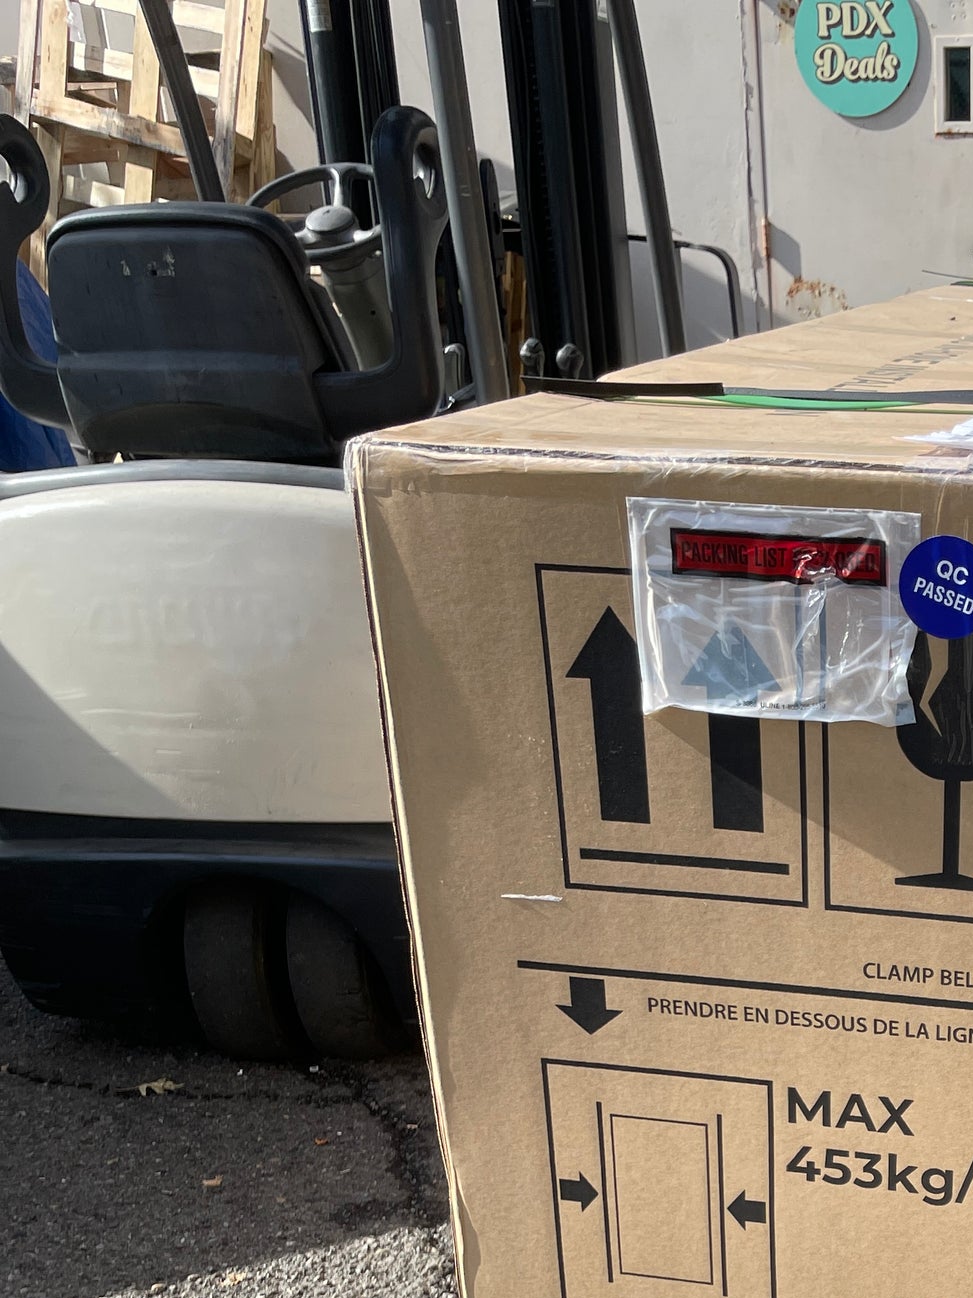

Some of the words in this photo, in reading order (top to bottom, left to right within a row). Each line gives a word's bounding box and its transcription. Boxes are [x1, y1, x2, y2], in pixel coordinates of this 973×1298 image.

[816, 1, 895, 39] PDX
[813, 41, 901, 84] Deals
[681, 541, 748, 565] PACKING
[754, 546, 787, 568] LIST
[936, 560, 969, 585] QC
[862, 962, 934, 985] CLAMP
[646, 997, 738, 1021] PRENDRE
[743, 1006, 770, 1025] EN
[775, 1008, 868, 1034] DESSOUS
[873, 1019, 899, 1037] DE
[904, 1022, 930, 1040] LA
[786, 1086, 915, 1137] MAX
